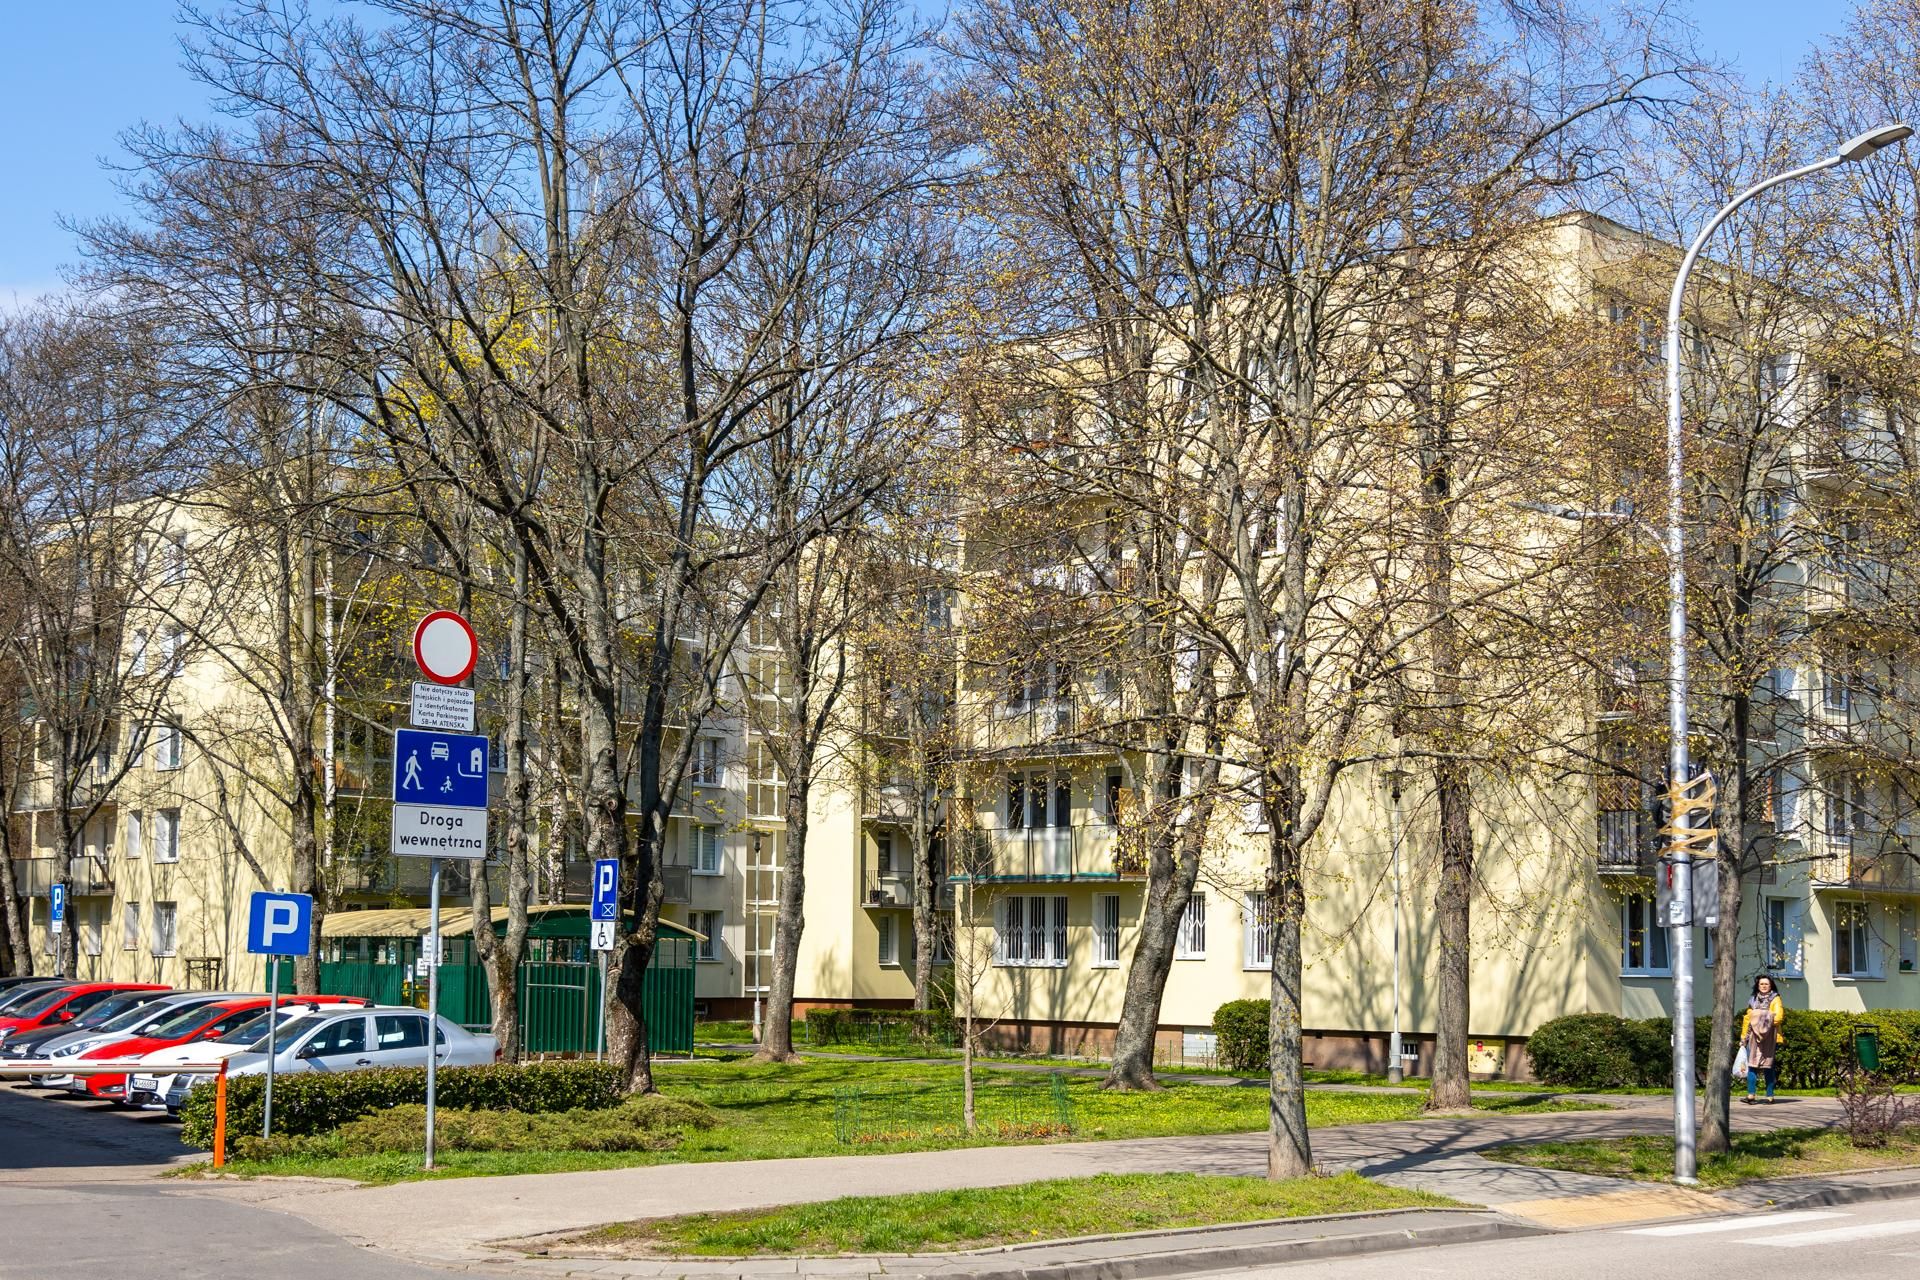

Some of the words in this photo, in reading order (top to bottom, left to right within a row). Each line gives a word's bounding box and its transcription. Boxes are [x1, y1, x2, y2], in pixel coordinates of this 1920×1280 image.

[415, 694, 441, 702] miejskich
[432, 688, 453, 696] dotyczy
[424, 702, 468, 712] identyfikatorem
[420, 811, 463, 830] Droga
[400, 835, 482, 850] wewnętrzna
[599, 865, 614, 902] P
[54, 887, 62, 911] P
[262, 899, 299, 947] P
